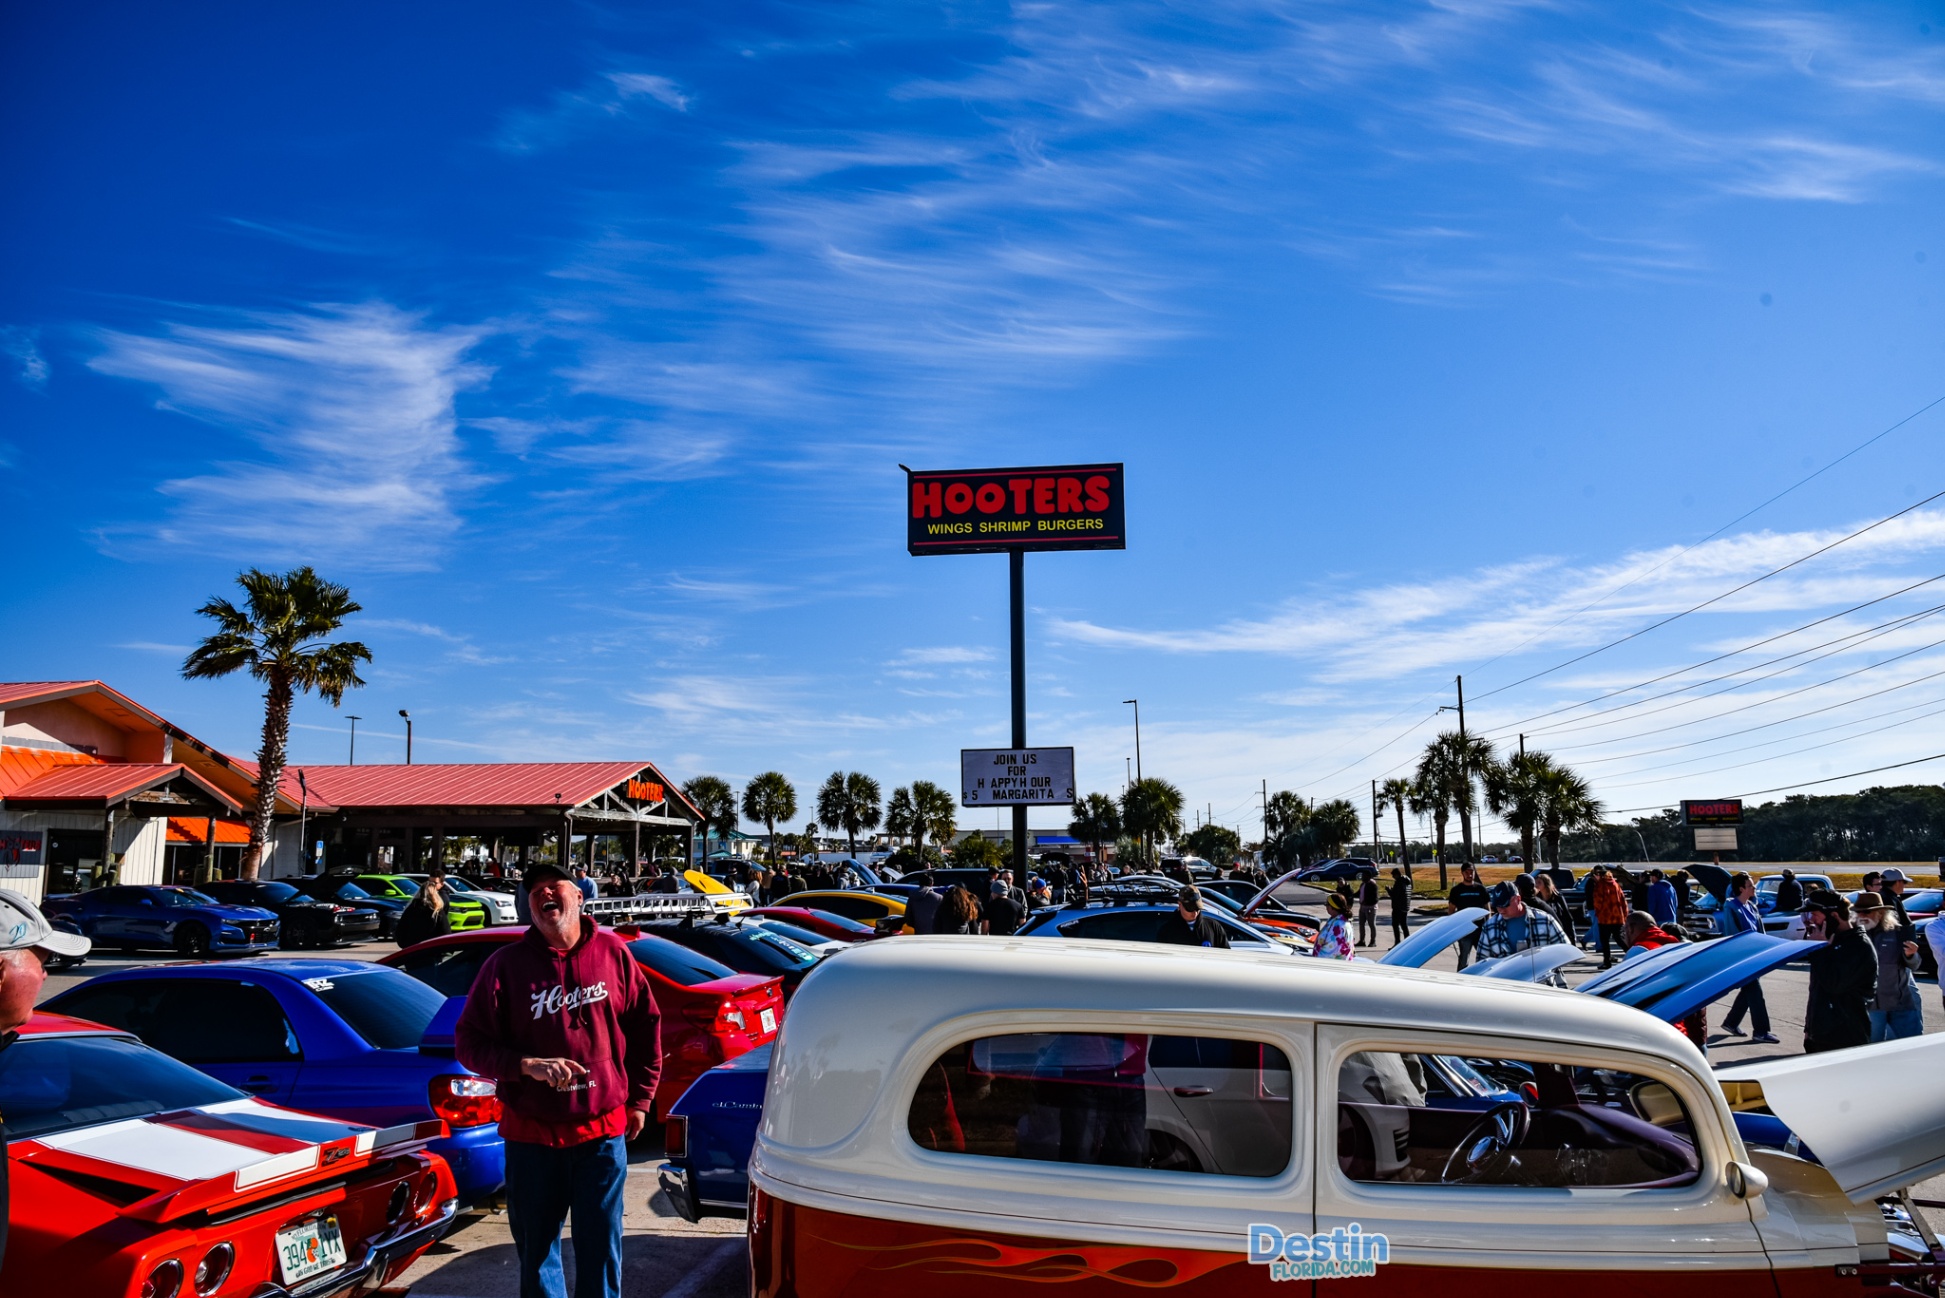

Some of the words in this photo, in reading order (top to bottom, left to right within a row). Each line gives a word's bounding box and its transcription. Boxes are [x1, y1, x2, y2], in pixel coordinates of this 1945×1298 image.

[912, 475, 1110, 518] HOOTERS
[927, 523, 973, 535] WINGS
[979, 521, 1031, 533] SHRIMP
[1037, 518, 1104, 531] BURGERS
[993, 754, 1017, 765] JOIN
[1022, 753, 1037, 765] US
[1007, 766, 1026, 776] FOR
[628, 778, 664, 803] HOOTERS
[1689, 803, 1739, 815] HOOTERS
[531, 981, 608, 1020] Hooters
